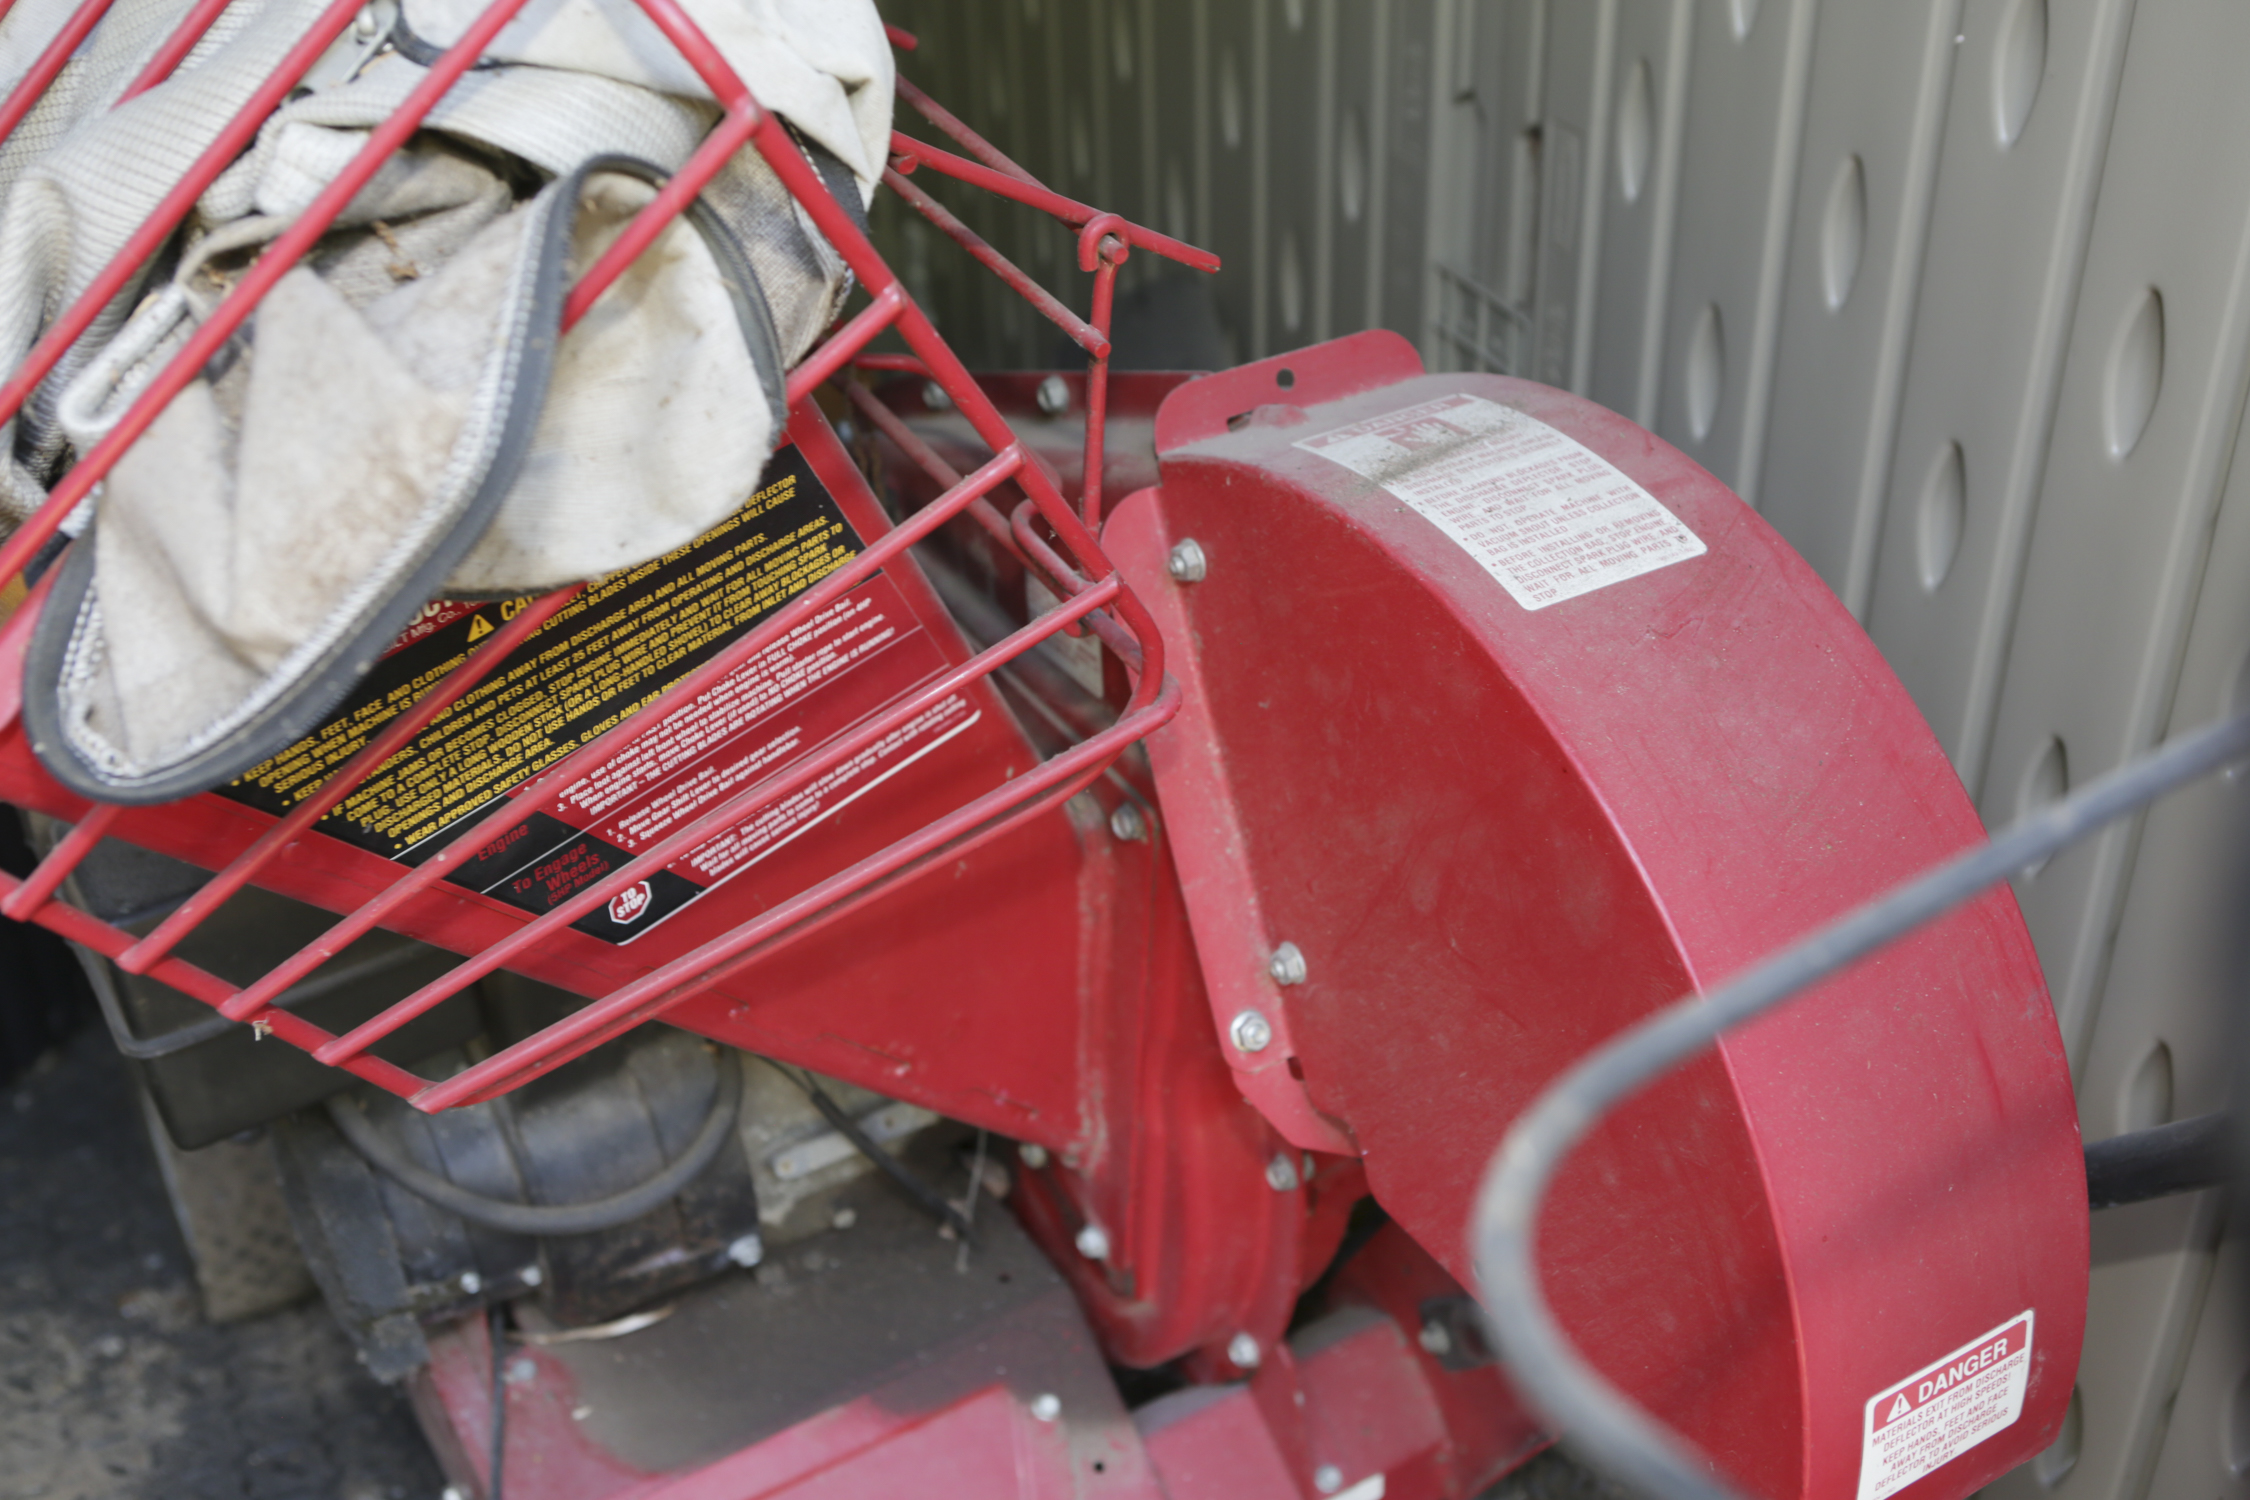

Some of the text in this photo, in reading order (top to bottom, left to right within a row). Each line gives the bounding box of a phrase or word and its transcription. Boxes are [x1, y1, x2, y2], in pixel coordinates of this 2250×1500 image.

[1478, 492, 1642, 547] VACUUM SNOUT UNLESS COLLECTION
[1488, 524, 1510, 533] NOT
[1514, 509, 1556, 525] OPERATE
[1560, 494, 1602, 510] MACHINE
[1606, 485, 1632, 496] WITH
[1498, 509, 1662, 565] BEFORE INSTALLING OR REMOVING
[1486, 545, 1508, 555] BAG
[1506, 564, 1526, 574] THE
[1526, 545, 1584, 567] COLLECTION
[1608, 529, 1632, 541] STOP
[1514, 560, 1574, 583] DISCONNECT
[1574, 550, 1606, 563] SPARK
[1604, 541, 1632, 553] PLUG
[1658, 526, 1680, 536] AND
[1522, 579, 1550, 592] WAIT
[1552, 572, 1574, 582] FOR
[1578, 564, 1596, 574] ALL
[1598, 550, 1638, 567] MOVING
[1638, 539, 1672, 553] PARTS
[244, 759, 273, 781] KEEP
[354, 699, 382, 721] FACE
[387, 683, 410, 703] AND
[412, 652, 466, 689] CLOTHING
[744, 474, 795, 508] DEFLECTOR
[259, 752, 310, 787] OPENING
[311, 733, 346, 758] WHEN
[347, 704, 398, 738] MACHINE
[399, 696, 411, 709] IS
[543, 600, 586, 630] CUTTING
[588, 578, 626, 606] BLADES
[627, 559, 659, 584] INSIDE
[662, 543, 691, 565] THESE
[692, 516, 740, 549] OPENINGS
[741, 504, 764, 522] WILL
[765, 487, 795, 510] CAUSE
[419, 712, 472, 749] CHILDREN
[473, 699, 496, 718] AND
[497, 684, 522, 704] PETS
[524, 675, 538, 689] AT
[539, 657, 571, 681] LEAST
[572, 649, 585, 662] 25
[586, 635, 610, 654] FEET
[611, 618, 640, 640] AWAY
[641, 601, 670, 623] FROM
[671, 571, 723, 607] OPERATING
[724, 560, 744, 577] AND
[745, 531, 796, 566] DISCHARGE
[797, 514, 829, 538] AREAS.
[293, 778, 322, 801] KEEP
[454, 676, 506, 711] CLOTHING
[506, 658, 537, 681] AWAY
[539, 640, 569, 663] FROM
[570, 608, 626, 646] DISCHARGE
[627, 593, 654, 614] AREA
[654, 582, 675, 599] AND
[676, 571, 694, 587] ALL
[695, 550, 733, 577] MOVING
[734, 531, 767, 555] PARTS.
[332, 803, 344, 816] IF
[345, 774, 395, 809] MACHINE
[396, 756, 426, 779] JAMS
[427, 746, 444, 762] OR
[444, 718, 494, 752] BECOMES
[548, 672, 575, 693] STOP
[576, 651, 612, 677] ENGINE
[613, 614, 678, 656] IMMEDIATELY
[678, 602, 699, 620] AND
[700, 588, 725, 607] WAIT
[725, 577, 745, 593] FOR
[745, 566, 763, 582] ALL
[764, 546, 800, 572] MOVING
[800, 530, 829, 552] PARTS
[830, 522, 843, 535] TO
[274, 759, 324, 793] SERIOUS
[325, 734, 370, 765] INJURY.
[387, 734, 555, 838] OPENINGS AND DISCHARGE AREA.
[629, 816, 651, 834] Move
[651, 804, 670, 820] Gear
[670, 792, 689, 808] Shift
[690, 778, 711, 796] Lever
[721, 756, 748, 777] desired
[749, 746, 766, 762] gear
[404, 820, 436, 846] WEAR
[437, 787, 493, 826] APPROVED
[492, 765, 531, 794] SAFETY
[618, 804, 650, 828] Release
[651, 788, 676, 808] Wheel
[676, 776, 697, 792] Drive
[477, 824, 529, 861] Engine
[513, 843, 587, 894] To Engage
[547, 852, 599, 890] Wheels
[575, 860, 609, 886] Model)
[620, 886, 636, 904] TO
[616, 892, 646, 918] STOP
[1872, 1353, 2023, 1446] MATERIALS EXIT FROM DISCHARGE
[1918, 1337, 2008, 1404] DANGER
[1883, 1373, 2010, 1451] DEFLECTOR AT HIGH SPEEDS!
[1883, 1447, 1904, 1464] KEEP
[1944, 1413, 1963, 1429] FEET
[1967, 1401, 1984, 1415] AND
[1987, 1387, 2008, 1404] FACE
[1891, 1404, 1996, 1470] AWAY FROM DISCHARGE
[1875, 1407, 2007, 1490] DEFLECTOR TO AVOID SERIOUS
[1923, 1447, 1956, 1471] INJURY.
